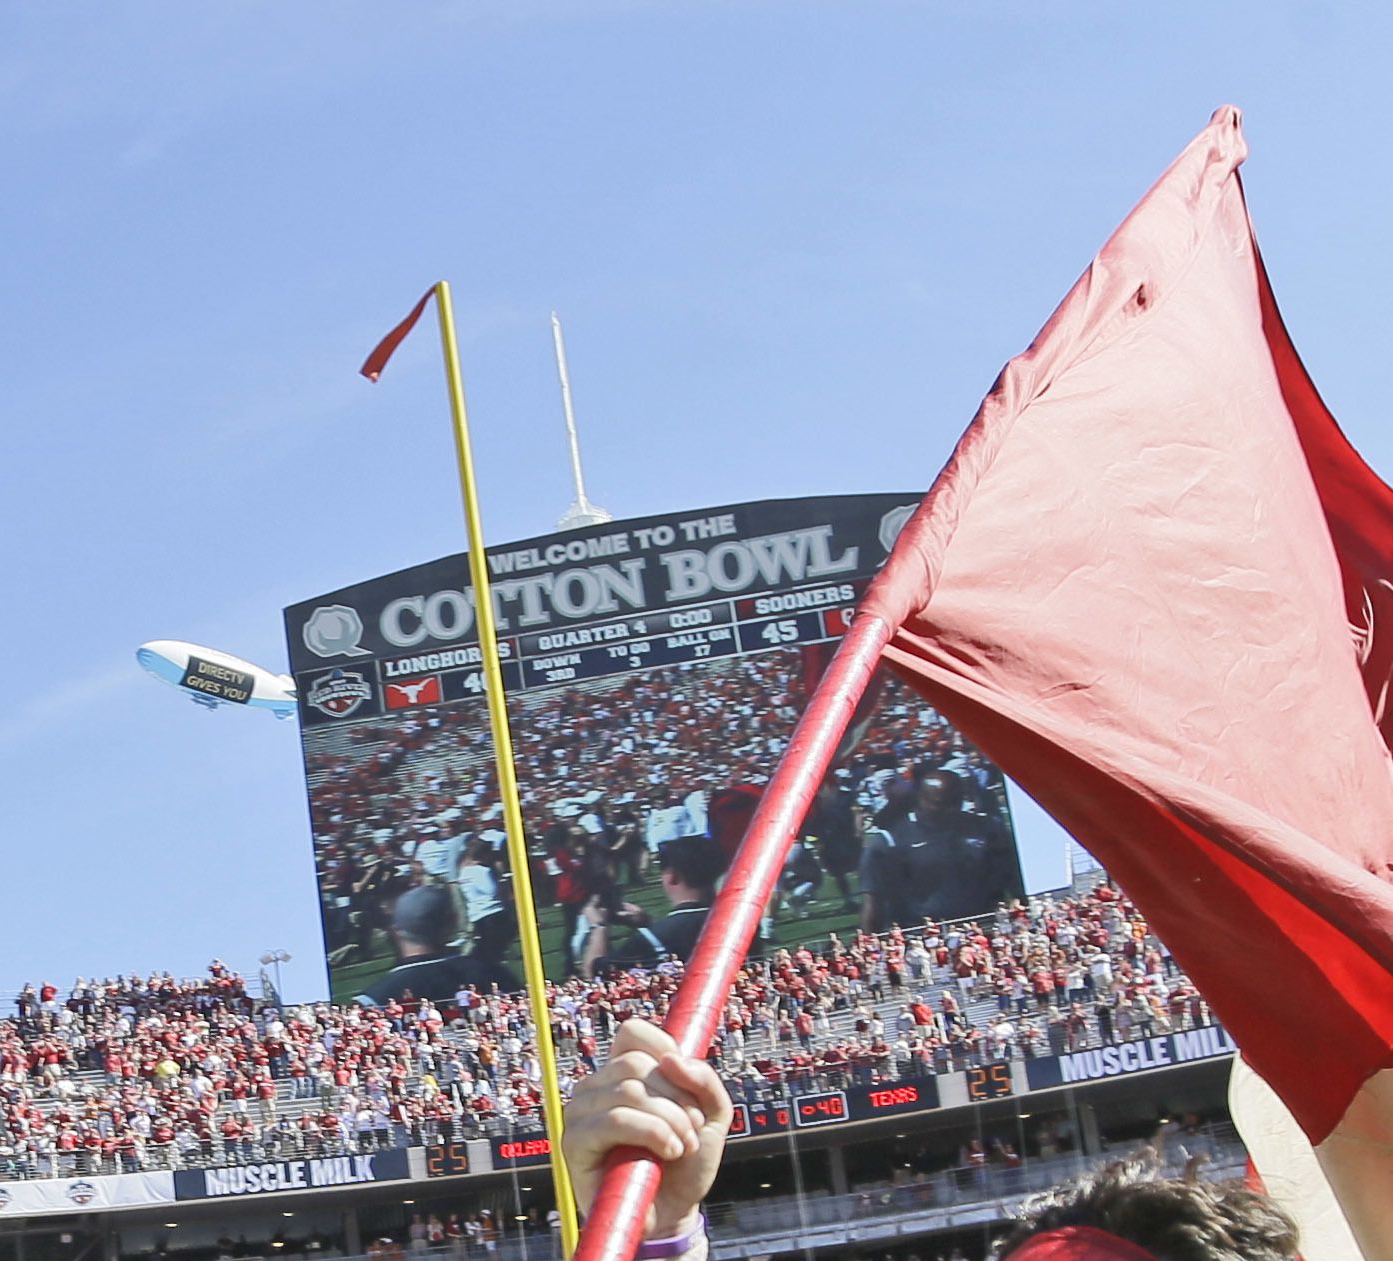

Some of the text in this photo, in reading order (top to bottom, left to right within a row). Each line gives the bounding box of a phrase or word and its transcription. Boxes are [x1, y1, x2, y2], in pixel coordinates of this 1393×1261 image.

[487, 514, 736, 575] WELCOME TO THE
[660, 524, 859, 602] BOWL
[756, 585, 855, 615] SOONERS
[539, 608, 712, 650] QUARTER 4 0:00
[667, 628, 732, 649] BALL ON
[761, 620, 799, 645] 45
[386, 641, 511, 678] LONGHORS
[532, 653, 582, 671] DOWN
[608, 641, 651, 658] TO GO
[694, 643, 712, 658] 17
[198, 662, 245, 685] DIRECTV
[545, 667, 576, 682] 3RD
[187, 675, 248, 700] GIVES YOU
[1059, 1037, 1173, 1084] MUSCLE
[969, 1065, 1011, 1099] 25
[868, 1086, 918, 1107] TEXAS
[429, 1144, 467, 1173] 25
[205, 1152, 377, 1196] MUSCLE MILK
